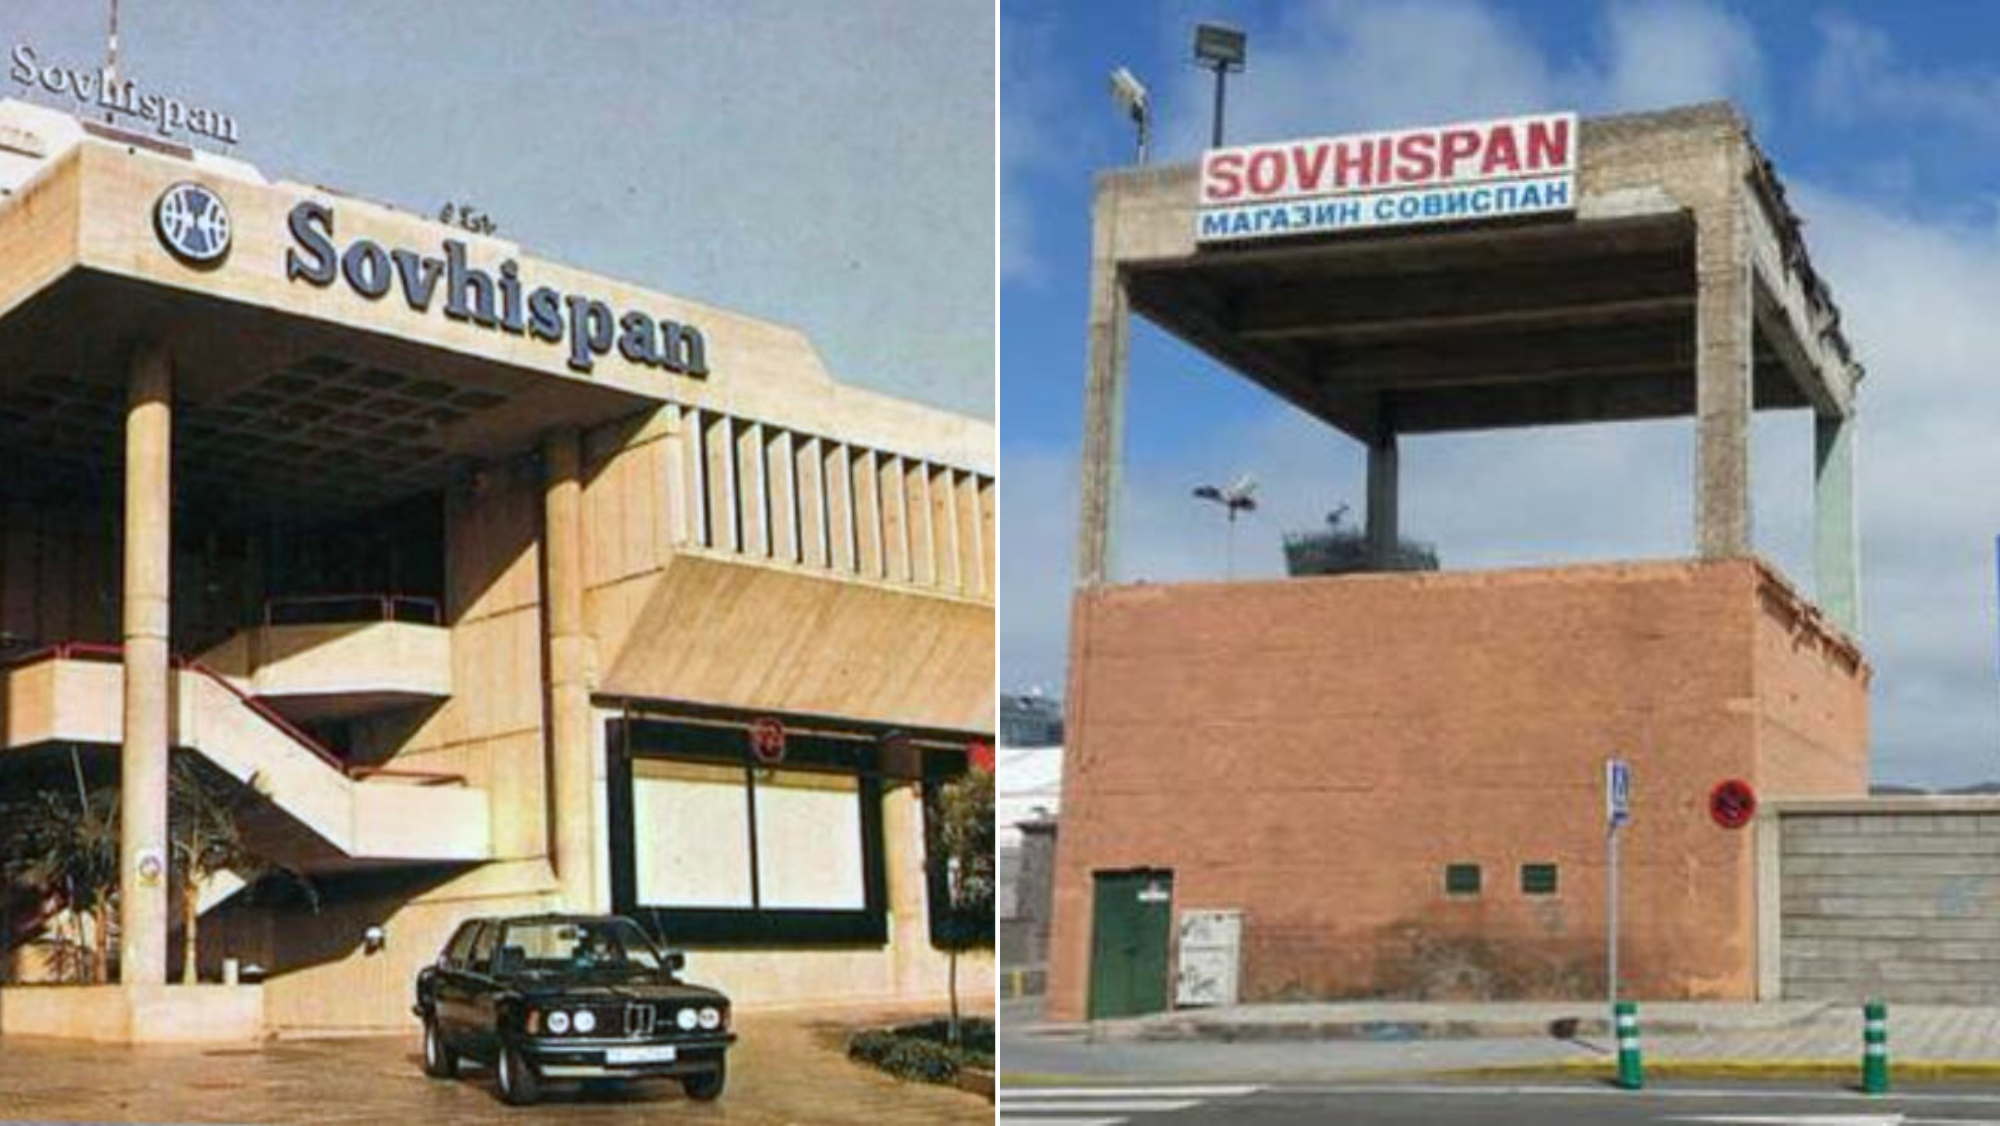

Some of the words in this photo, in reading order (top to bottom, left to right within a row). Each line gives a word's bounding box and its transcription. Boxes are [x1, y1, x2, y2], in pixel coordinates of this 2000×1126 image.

[10, 43, 239, 144] Sovhispan
[1206, 119, 1569, 199] SOVHISPAN
[1202, 206, 1360, 235] МАГАЗИН
[1375, 181, 1569, 221] СОВИСПАН
[286, 201, 708, 379] Sovhispan
